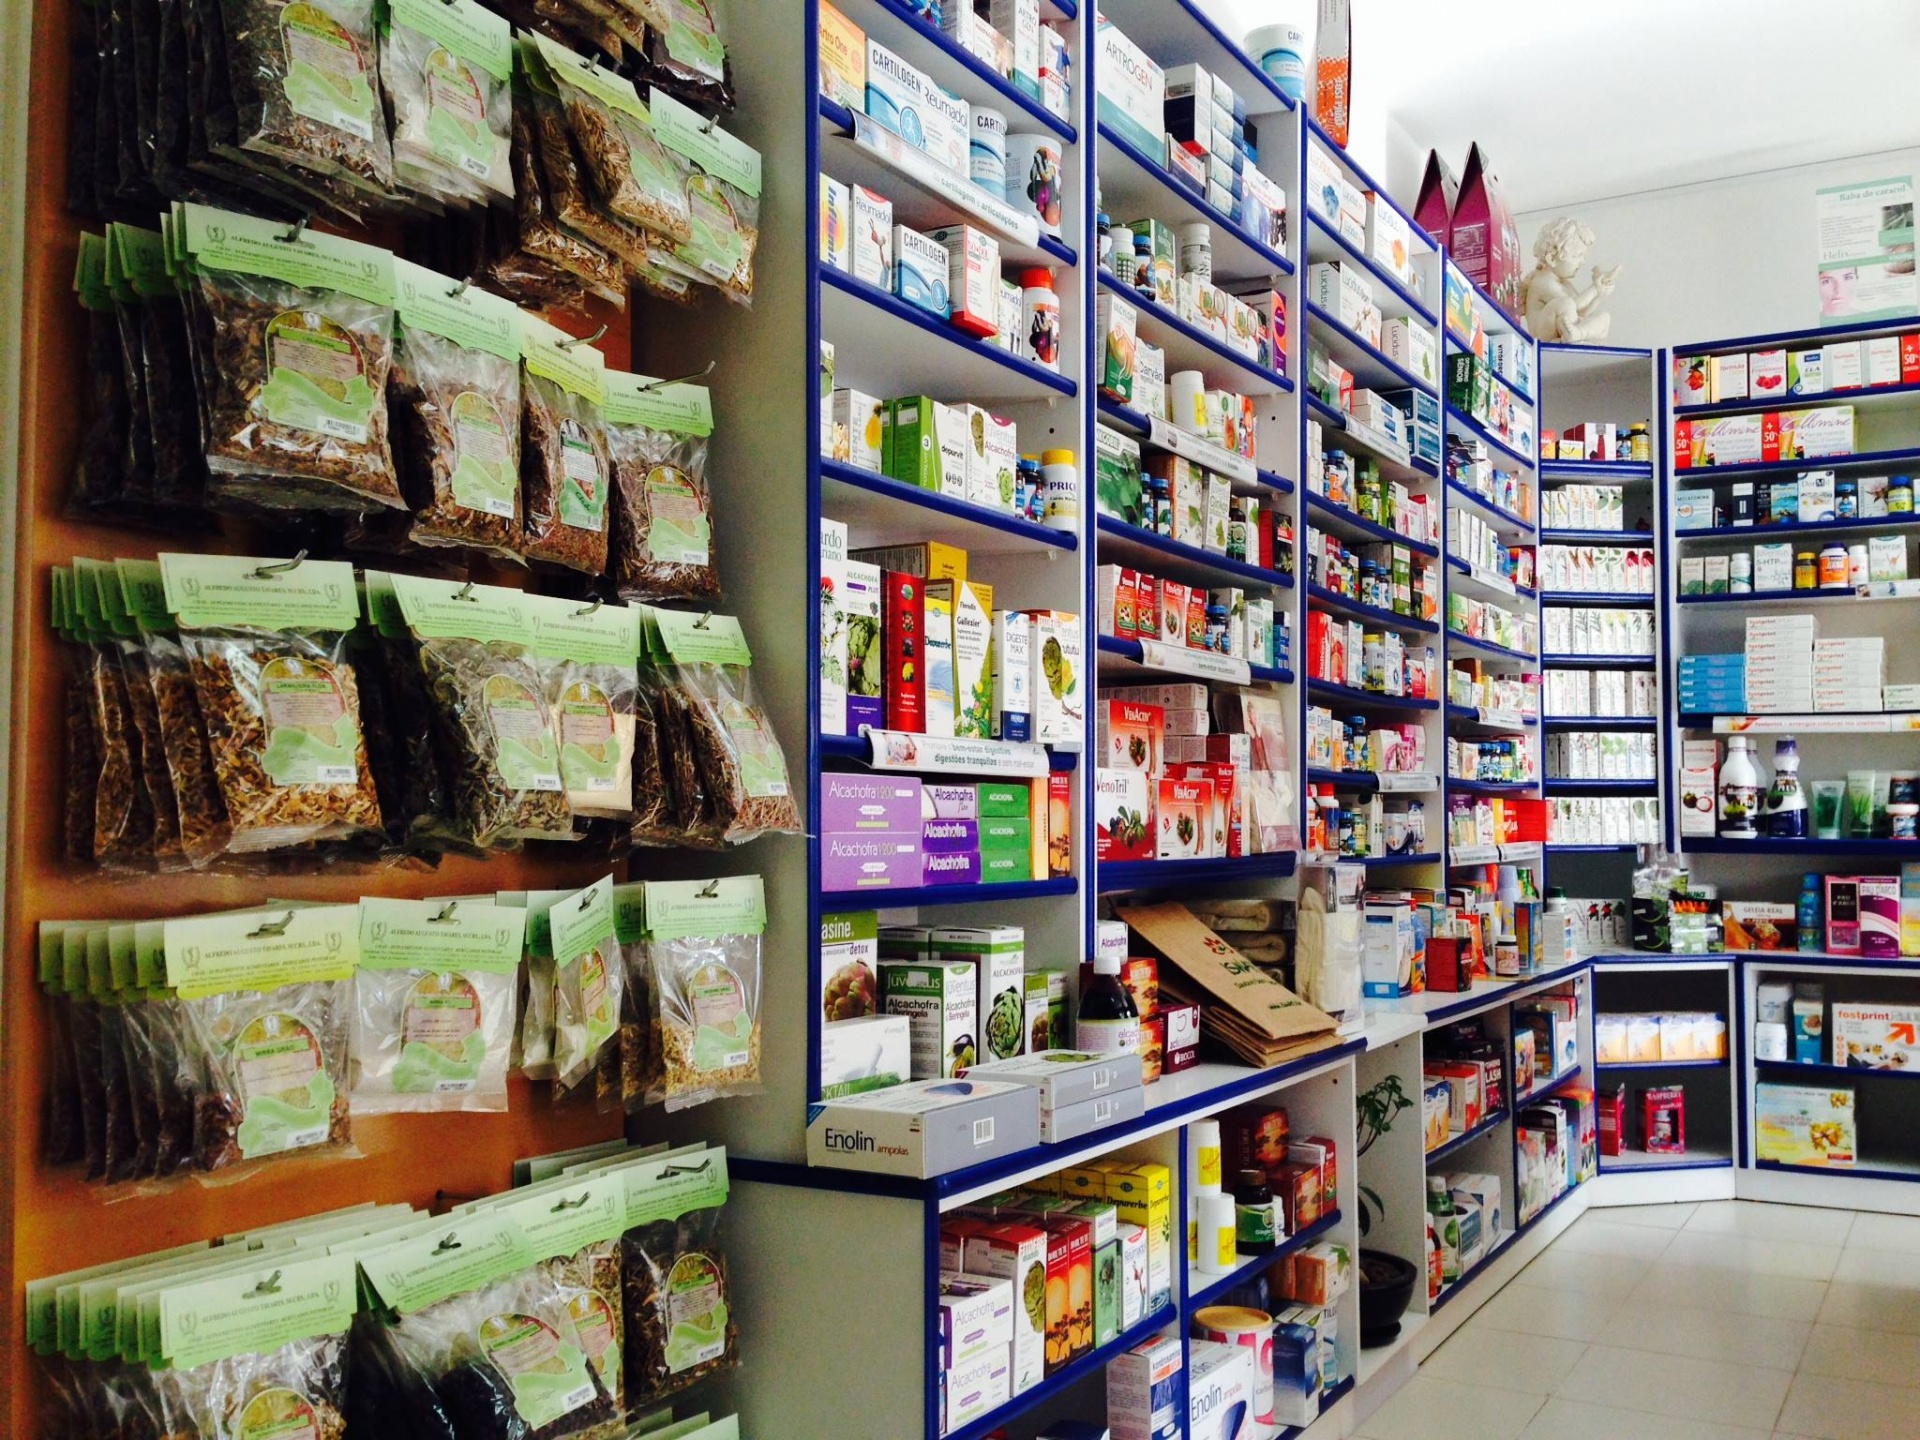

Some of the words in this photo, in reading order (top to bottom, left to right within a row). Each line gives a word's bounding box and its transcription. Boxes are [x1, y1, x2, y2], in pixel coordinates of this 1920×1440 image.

[872, 48, 921, 94] CARTILOGEN
[1105, 40, 1153, 91] ARTROGEN
[924, 86, 968, 129] Reumadol
[856, 196, 891, 225] Reumadol
[903, 231, 948, 267] CARTILOGEN
[941, 445, 964, 460] depurvit
[984, 441, 1016, 460] Alcachofra
[1010, 643, 1024, 655] MAX
[935, 754, 965, 765] digestões
[967, 756, 997, 767] tranquilas
[829, 781, 876, 799] Alcachofra
[934, 787, 974, 802] Alcachofra
[924, 823, 967, 838] Alcachofra
[830, 840, 877, 858] Alcachofra
[928, 856, 970, 871] Alcachofra
[821, 916, 852, 940] asine
[849, 942, 869, 955] detox
[888, 999, 939, 1010] Alcachofra
[945, 997, 975, 1013] Alcachofra
[824, 1128, 875, 1152] Enolin
[877, 1145, 909, 1156] ampolas
[1106, 1195, 1148, 1211] Depurerbe
[954, 1300, 995, 1328] Alcachofra
[951, 1362, 991, 1392] Alcachofra
[1191, 1379, 1223, 1422] Enolin
